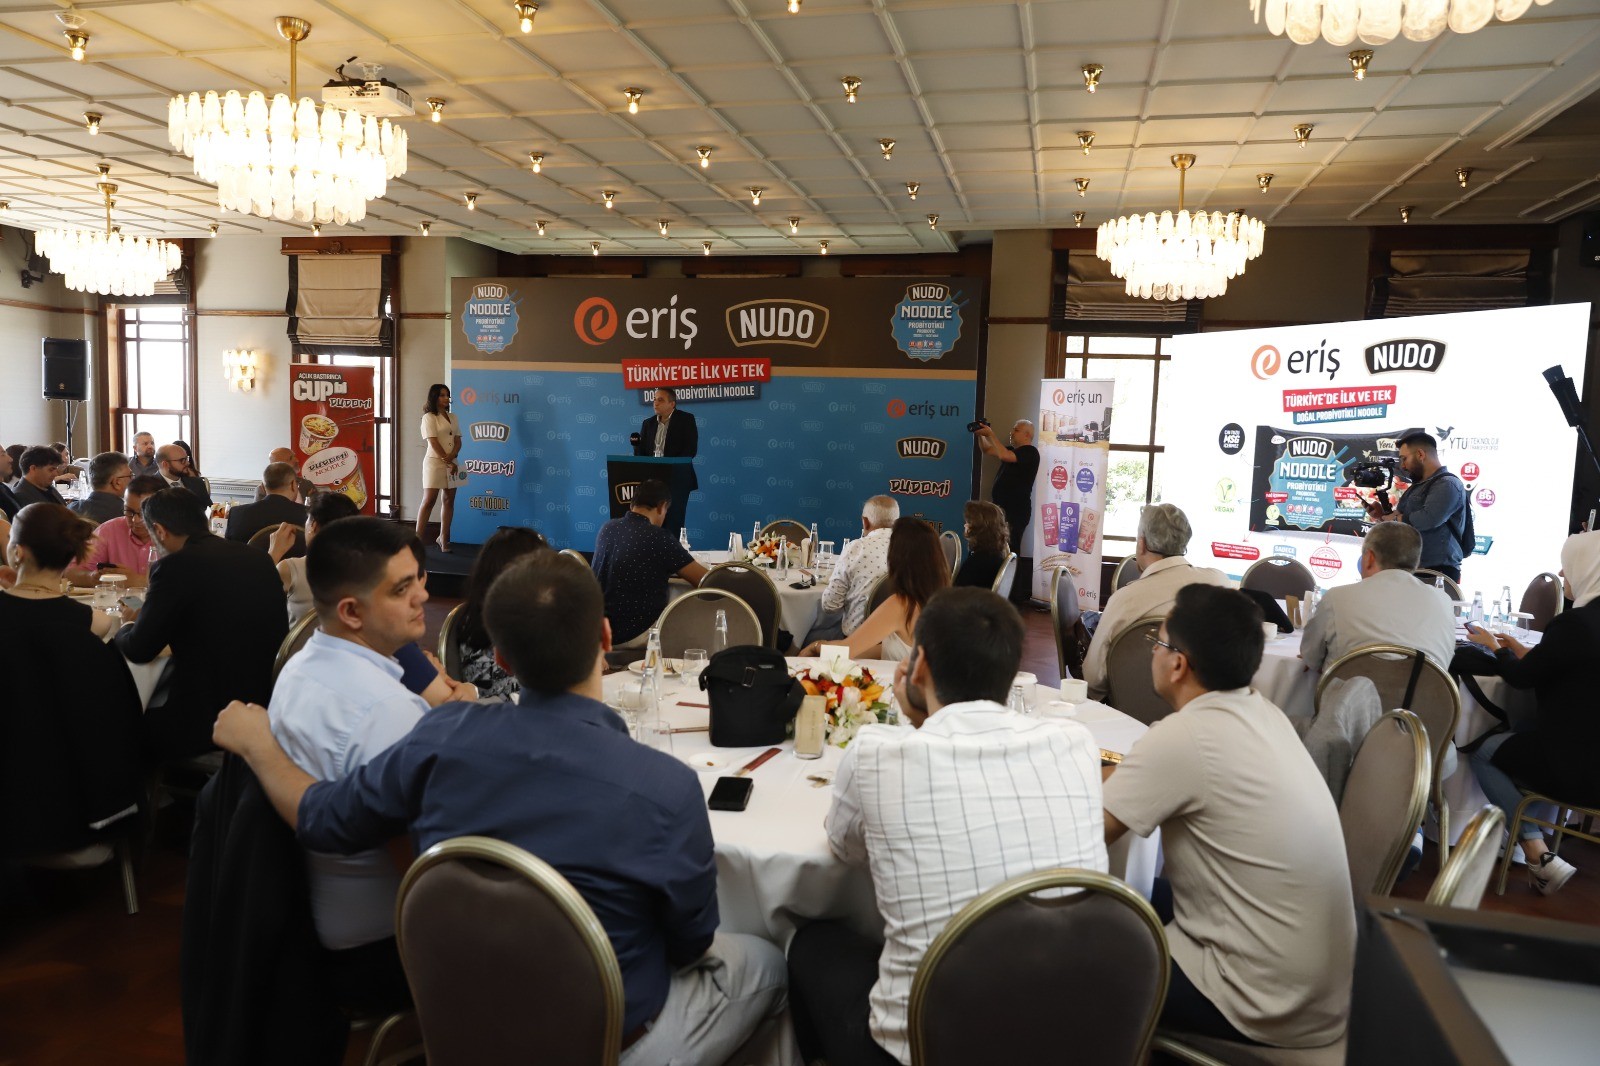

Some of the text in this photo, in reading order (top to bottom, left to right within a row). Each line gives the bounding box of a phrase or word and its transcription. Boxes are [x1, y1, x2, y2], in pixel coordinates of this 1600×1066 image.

[477, 286, 503, 298] NUDO
[912, 286, 943, 299] NUDO
[469, 303, 511, 315] NOODLE
[901, 305, 953, 319] NOODLE
[625, 294, 698, 350] eriş
[739, 307, 815, 339] NUDO
[1287, 339, 1341, 381] eriş
[1373, 343, 1436, 371] NUDO
[700, 362, 721, 379] İLK
[722, 364, 739, 378] VE
[740, 363, 765, 378] TEK
[293, 380, 334, 402] CUP
[503, 393, 520, 404] un
[723, 385, 755, 397] NOODLE
[1066, 389, 1102, 406] eriş un
[1340, 389, 1356, 404] İLK
[1357, 390, 1371, 403] VE
[1371, 389, 1392, 402] TEK
[908, 400, 960, 419] eriş un
[1296, 411, 1316, 422] DOĞAL
[1357, 407, 1383, 418] NOODLE
[474, 425, 505, 439] NUDO
[1223, 434, 1241, 444] MSG
[903, 440, 940, 456] NUDO
[1292, 440, 1327, 456] NUDO
[1279, 461, 1337, 480] NOODLE
[1464, 464, 1476, 474] B1
[470, 496, 510, 510] EGG NOODLE
[1478, 491, 1493, 501] B6
[1214, 505, 1235, 513] VEGAN
